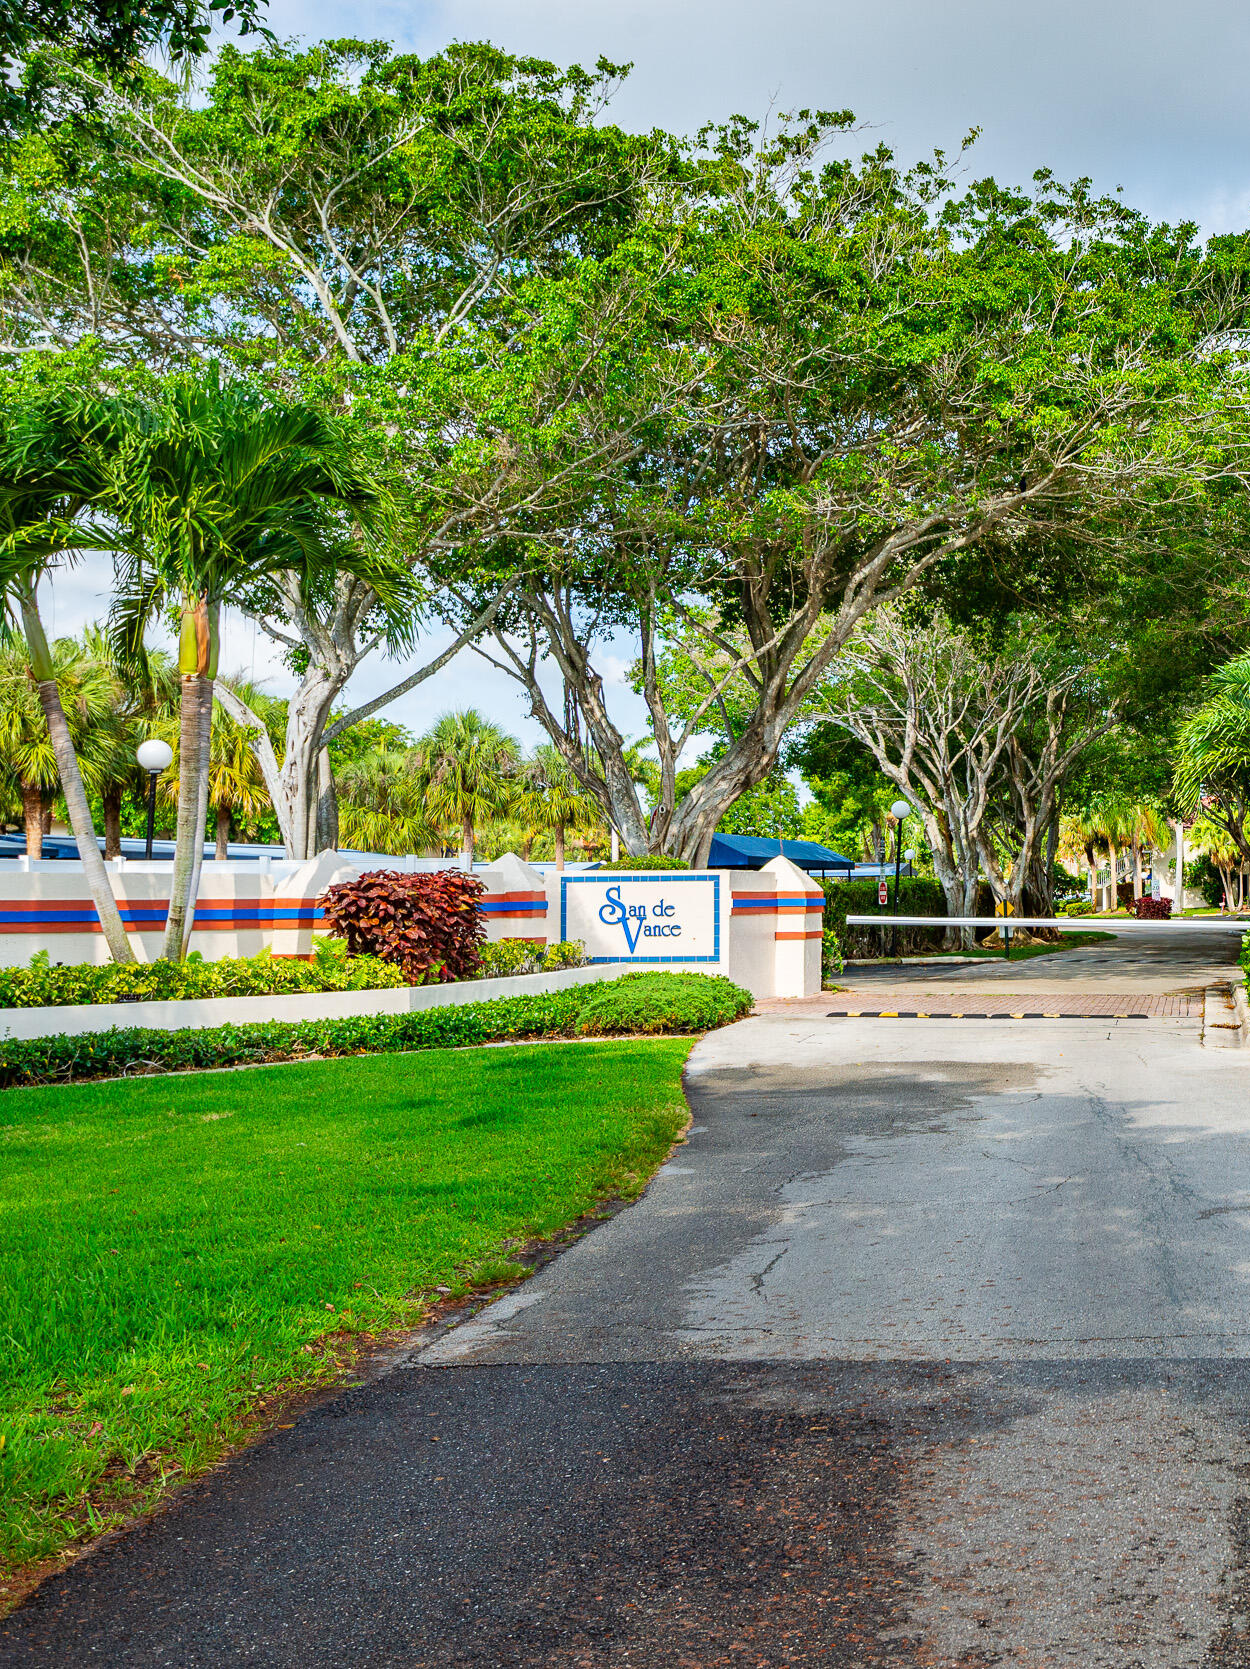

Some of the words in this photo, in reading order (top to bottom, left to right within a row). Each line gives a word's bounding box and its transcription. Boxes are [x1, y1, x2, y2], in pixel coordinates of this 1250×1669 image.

[598, 885, 646, 925] San
[652, 898, 675, 917] de
[617, 917, 681, 954] Vance
